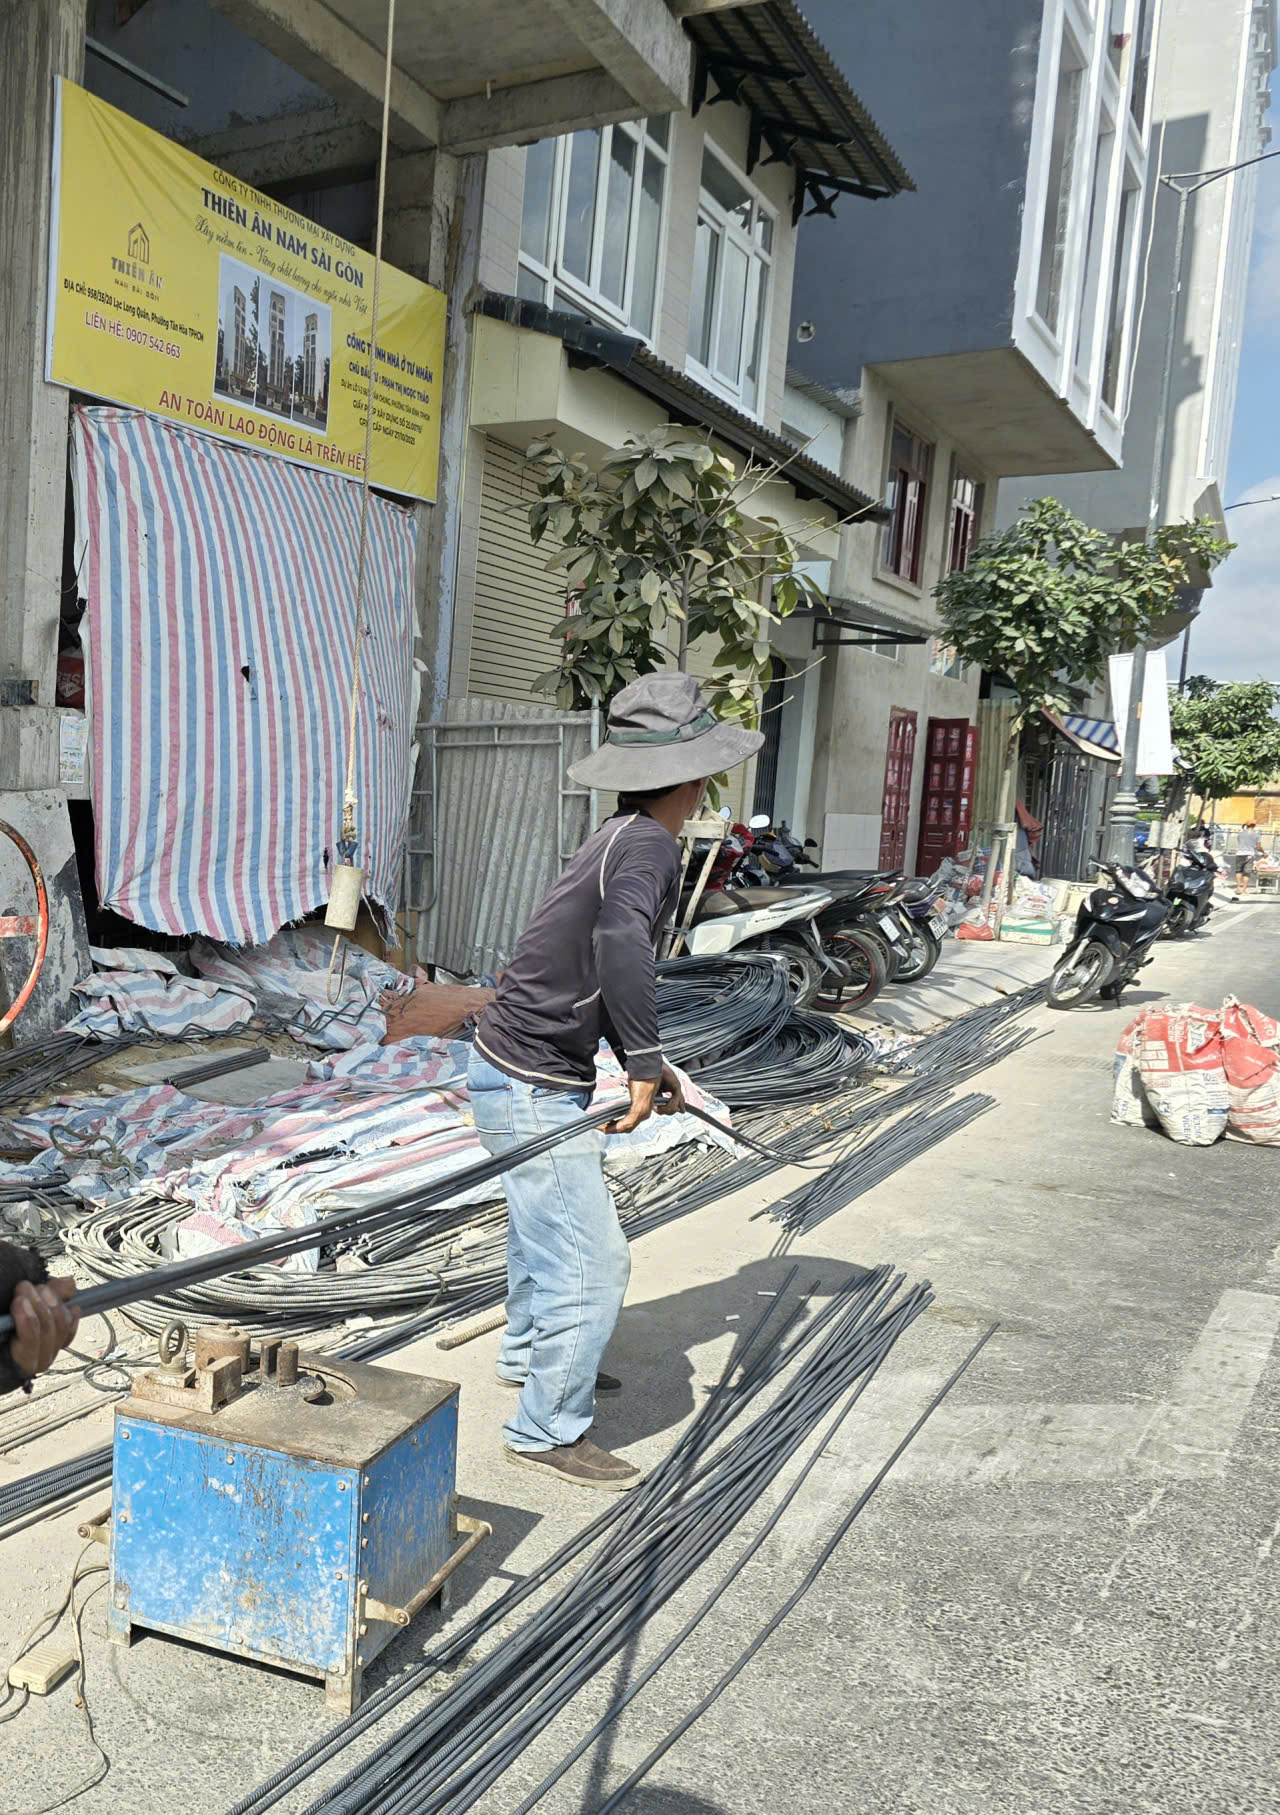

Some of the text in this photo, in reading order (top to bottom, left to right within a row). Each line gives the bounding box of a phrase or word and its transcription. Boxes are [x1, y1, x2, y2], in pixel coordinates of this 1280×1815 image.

[239, 184, 249, 198] TY
[250, 190, 271, 210] TNHH
[273, 204, 305, 229] THƯƠNG
[201, 187, 363, 288] THIÊN ÂN NAM SÀI GÒN
[111, 256, 145, 281] THIÊN
[64, 278, 74, 293] ĐỊA
[113, 297, 122, 312] Lạc
[123, 301, 136, 317] Long
[85, 311, 106, 331] LIÊN
[126, 327, 147, 345] 0907
[149, 336, 163, 352] 542
[166, 342, 180, 358] 663
[159, 390, 182, 412] AN
[186, 399, 224, 426] TOÀN
[229, 414, 255, 435] LAO
[259, 424, 295, 450] ĐỘNG
[299, 433, 312, 455] LÀ
[317, 443, 345, 466] TRÊN
